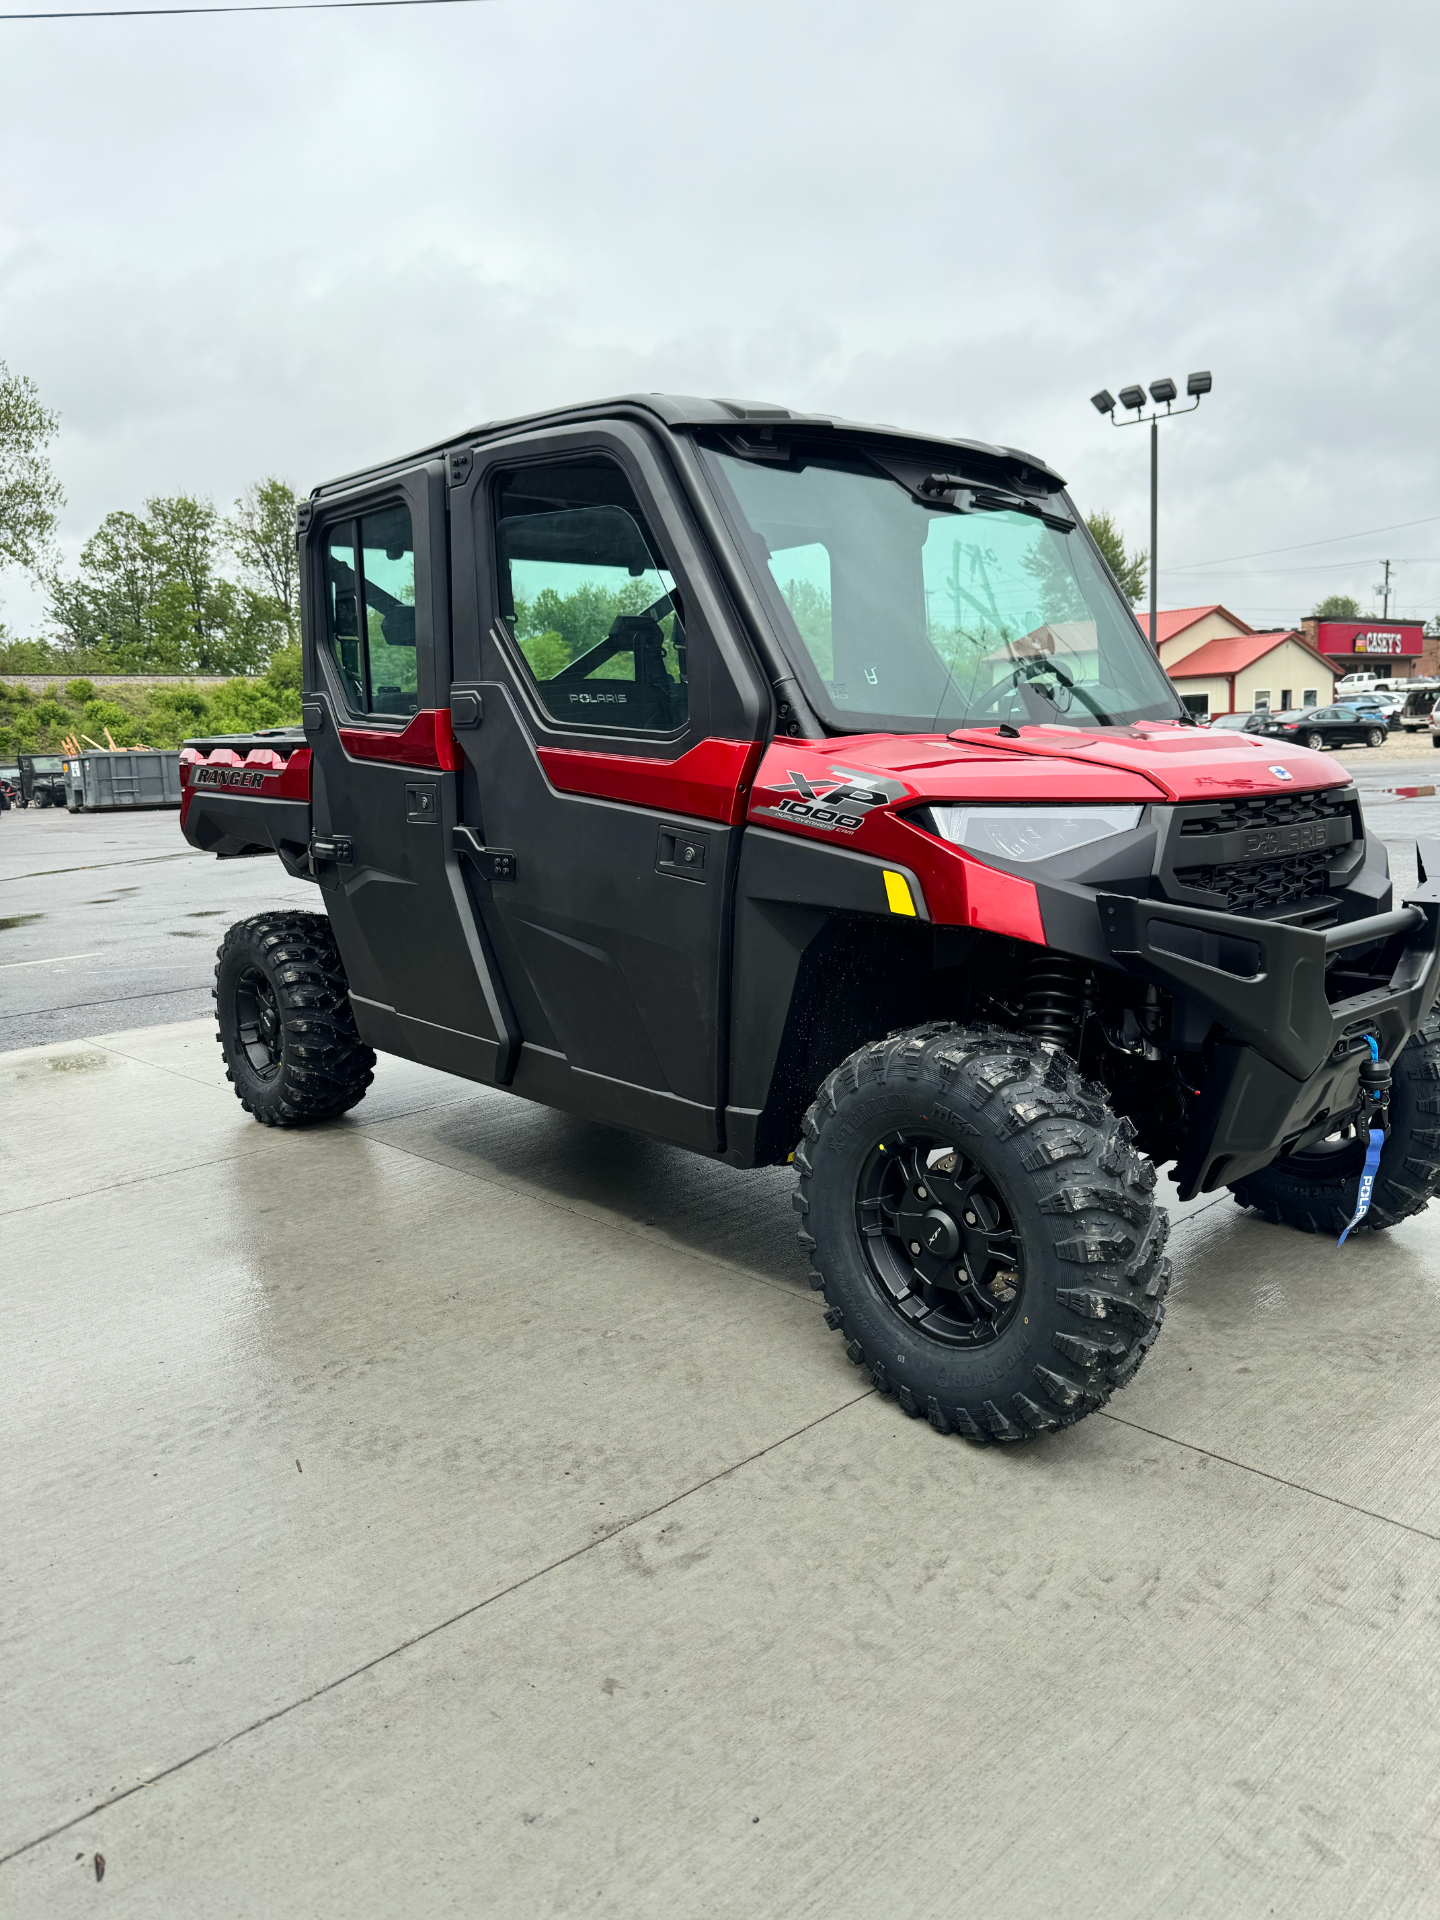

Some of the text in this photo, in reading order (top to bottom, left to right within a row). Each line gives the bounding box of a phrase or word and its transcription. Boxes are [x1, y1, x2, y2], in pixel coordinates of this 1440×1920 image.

[1366, 632, 1402, 654] CASEY'S
[568, 693, 627, 703] POLARIS
[197, 768, 264, 789] RANGER
[762, 770, 890, 808] XP
[774, 812, 854, 835] DUAL OVERHEAD CAM
[779, 799, 865, 830] 1000
[1244, 823, 1326, 856] POLARIS
